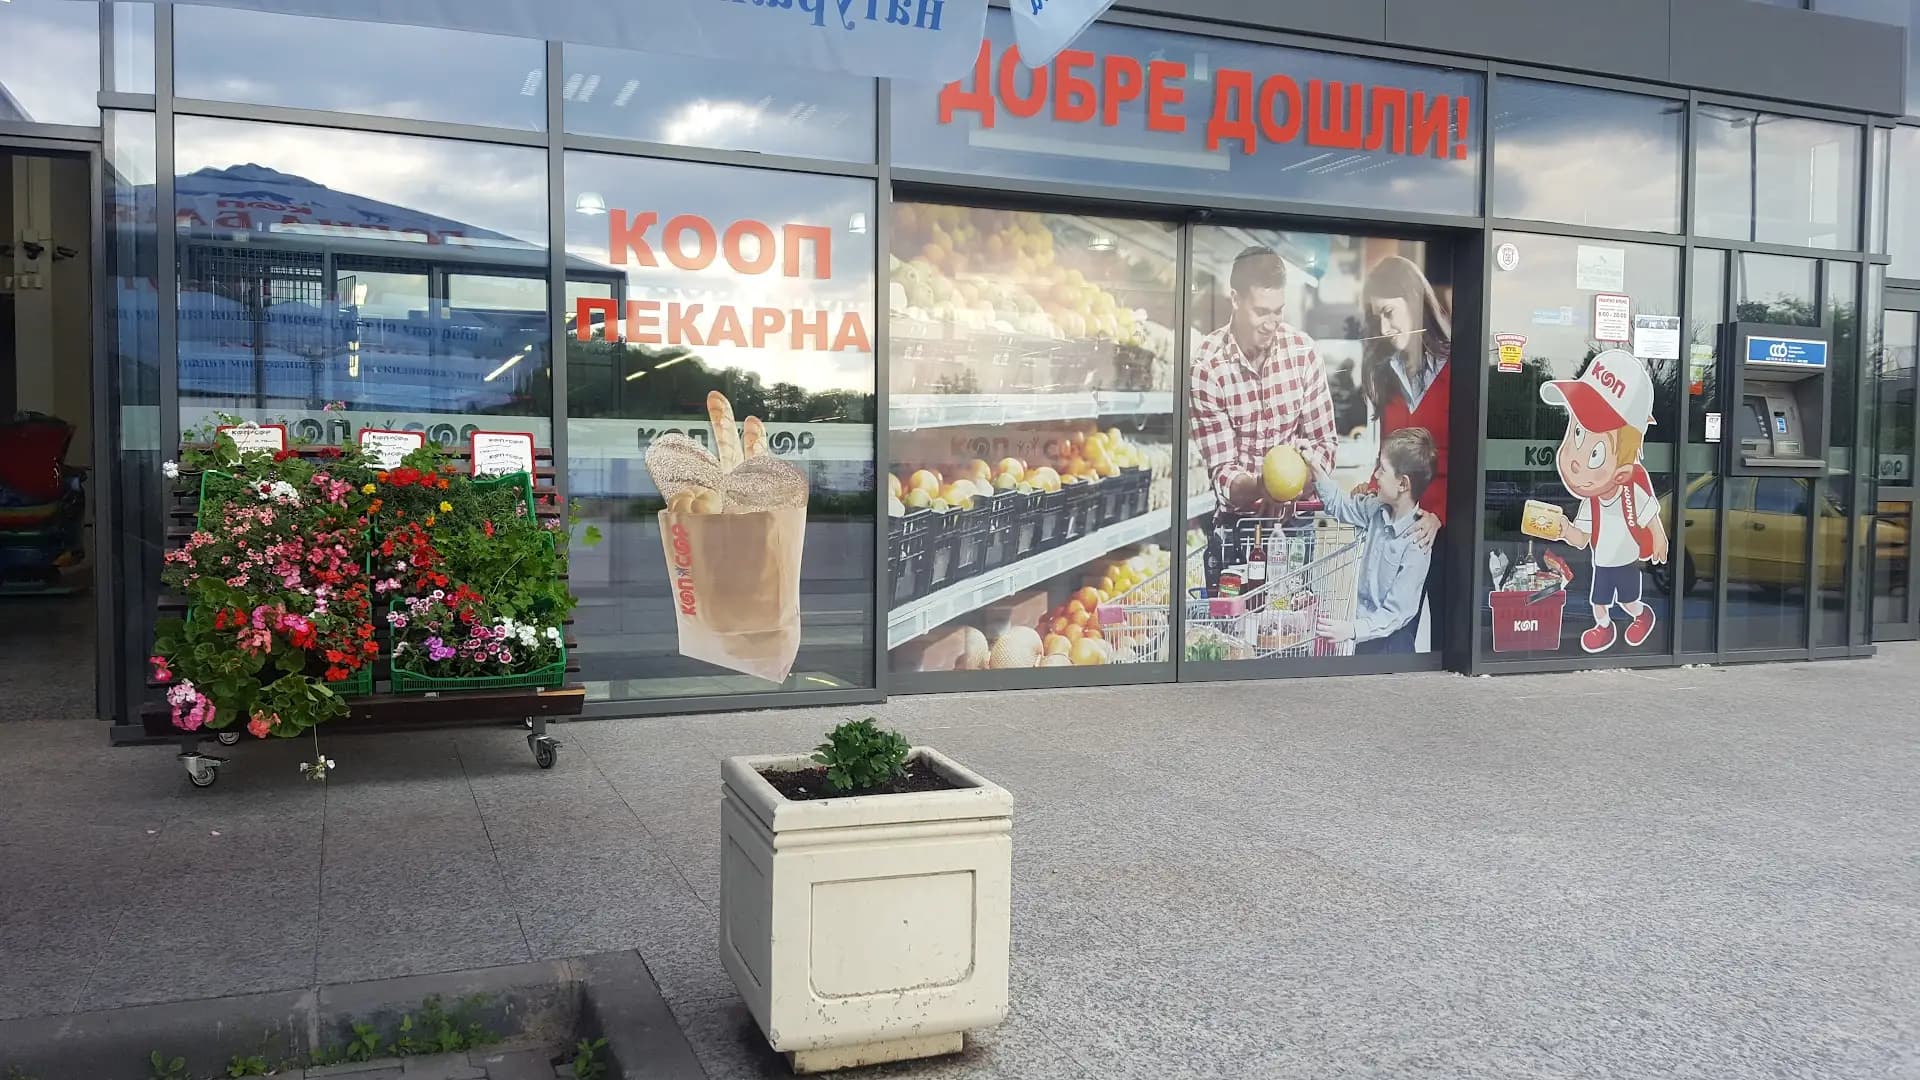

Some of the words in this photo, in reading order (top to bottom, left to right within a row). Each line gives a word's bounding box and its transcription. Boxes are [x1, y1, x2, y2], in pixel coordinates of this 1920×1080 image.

[939, 38, 1187, 133] ДОБРЕ
[1206, 68, 1470, 161] ДОШЛИ!
[609, 208, 831, 279] КООП
[575, 297, 874, 353] ПЕКАРНА
